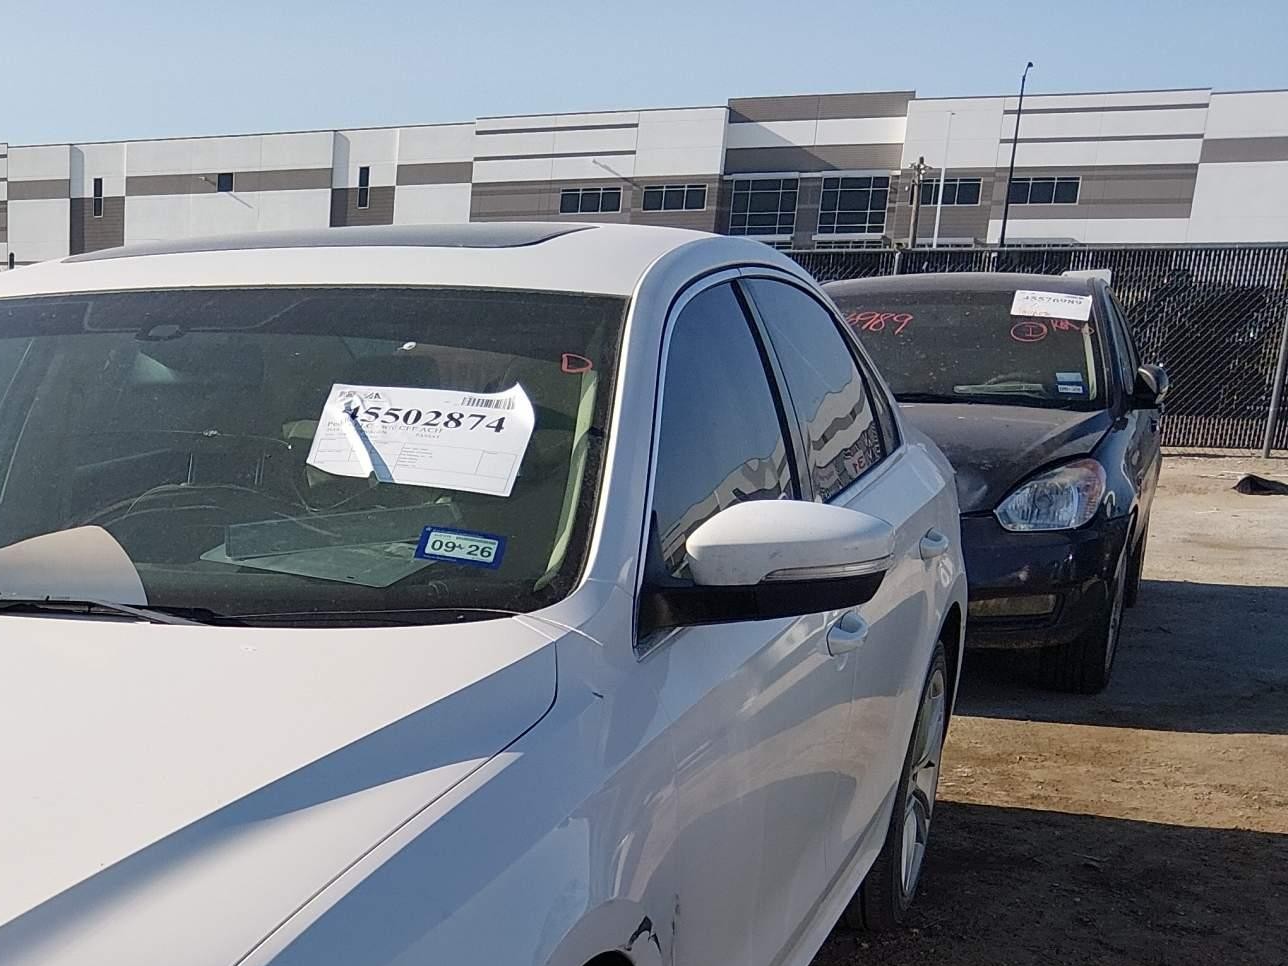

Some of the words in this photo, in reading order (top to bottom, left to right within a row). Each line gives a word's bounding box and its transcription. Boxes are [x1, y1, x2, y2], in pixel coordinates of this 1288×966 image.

[562, 353, 593, 373] D
[431, 539, 456, 553] 09
[466, 544, 494, 559] 26
